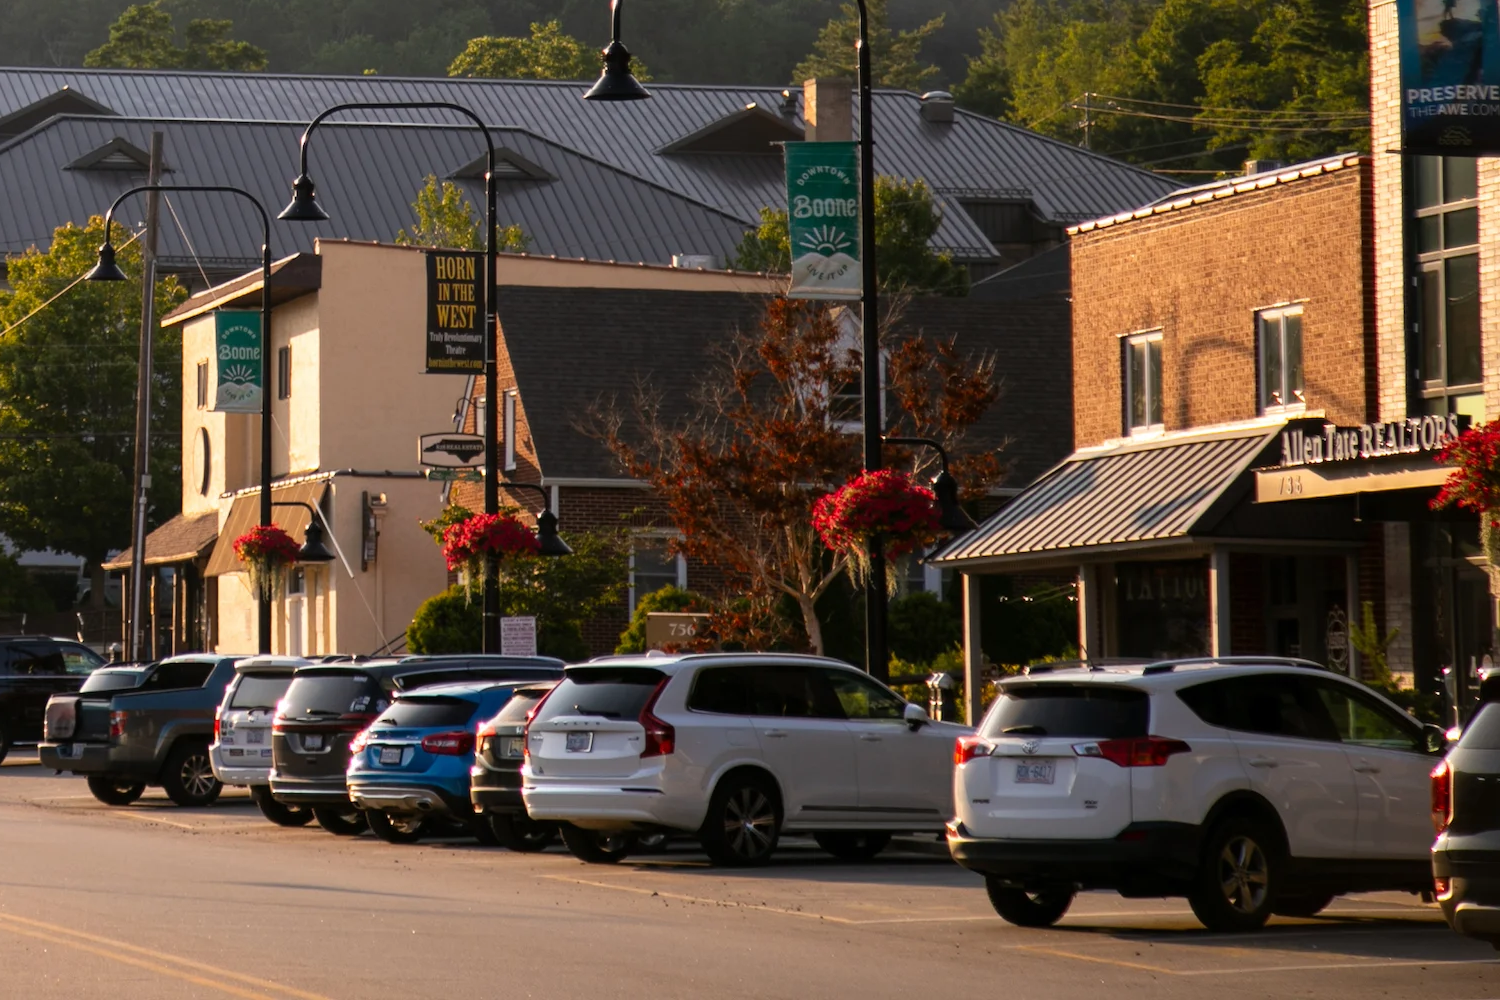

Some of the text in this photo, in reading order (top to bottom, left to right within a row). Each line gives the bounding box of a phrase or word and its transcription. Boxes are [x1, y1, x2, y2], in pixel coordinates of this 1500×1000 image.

[1407, 85, 1500, 104] PRESERVE
[796, 165, 851, 187] DOWNTOWN
[793, 194, 857, 219] Boone
[435, 256, 475, 280] HORN
[805, 263, 850, 281] LIVE IT UP
[438, 283, 475, 302] IN THE
[436, 304, 477, 329] WEST
[221, 325, 257, 340] DOWNTOWN
[429, 332, 443, 343] Truly
[219, 344, 261, 361] Boone
[445, 344, 467, 355] Theatre
[1280, 413, 1459, 466] Allen Tate REALTORS
[669, 623, 696, 637] 756
